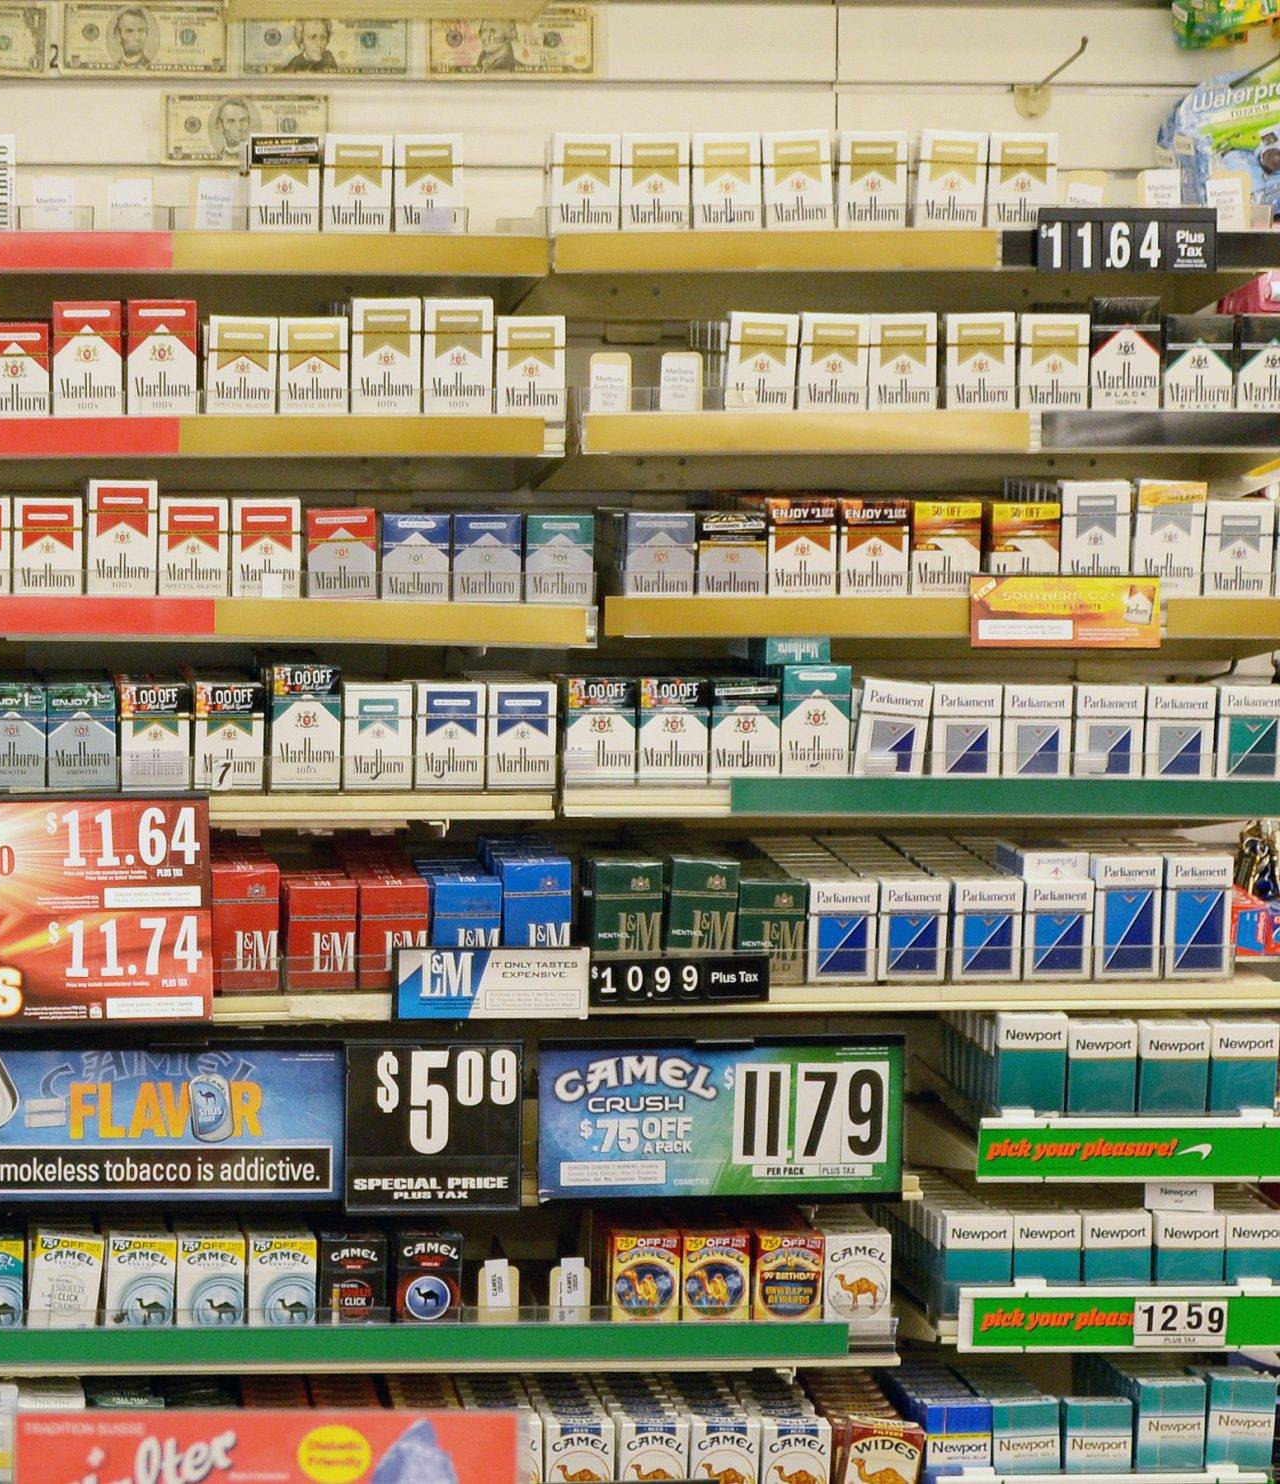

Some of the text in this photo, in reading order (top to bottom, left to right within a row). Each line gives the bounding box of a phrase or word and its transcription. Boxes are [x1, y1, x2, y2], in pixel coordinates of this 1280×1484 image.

[258, 202, 312, 228] Marlboro
[774, 195, 827, 222] Marlboro
[1041, 221, 1161, 268] $11.64
[1176, 230, 1204, 244] Plus
[1179, 244, 1202, 257] Tax
[359, 371, 414, 398] Marlboro
[772, 507, 809, 519] ENJOY
[389, 573, 443, 595] Marlboro
[870, 690, 925, 708] Parliament
[1155, 696, 1209, 710] Parliament
[497, 747, 549, 773] Marlboro
[46, 806, 200, 868] $11.64
[157, 869, 172, 877] PLUS
[1034, 889, 1087, 903] Parliament
[48, 915, 203, 978] $11.74
[235, 929, 279, 971] L&M
[503, 961, 535, 969] ONLY
[537, 961, 579, 969] TASTES
[420, 951, 475, 998] L&M
[501, 971, 569, 979] EXPENSIVE.
[591, 965, 698, 998] $10.99
[1005, 1028, 1062, 1044] Newport
[554, 1056, 718, 1103] CAMEL
[68, 1078, 264, 1141] FLAVR
[587, 1096, 684, 1113] CRUSH
[641, 1118, 693, 1139] OFF
[985, 1139, 1178, 1160] pick your pleasure!
[104, 1159, 192, 1182] tobacco
[196, 1159, 216, 1181] is
[219, 1157, 321, 1182] addictive.
[766, 1165, 856, 1175] PER PACK PLUS TAX
[353, 1176, 509, 1192] SPECIAL PRICE
[393, 1190, 469, 1200] PLUS TAX
[951, 1226, 1008, 1241] Newport
[1090, 1226, 1146, 1241] Newport
[402, 1241, 459, 1260] CAMEL
[1218, 1415, 1272, 1431] Newport
[552, 1437, 609, 1455] CAMEL
[853, 1438, 917, 1462] WIDES
